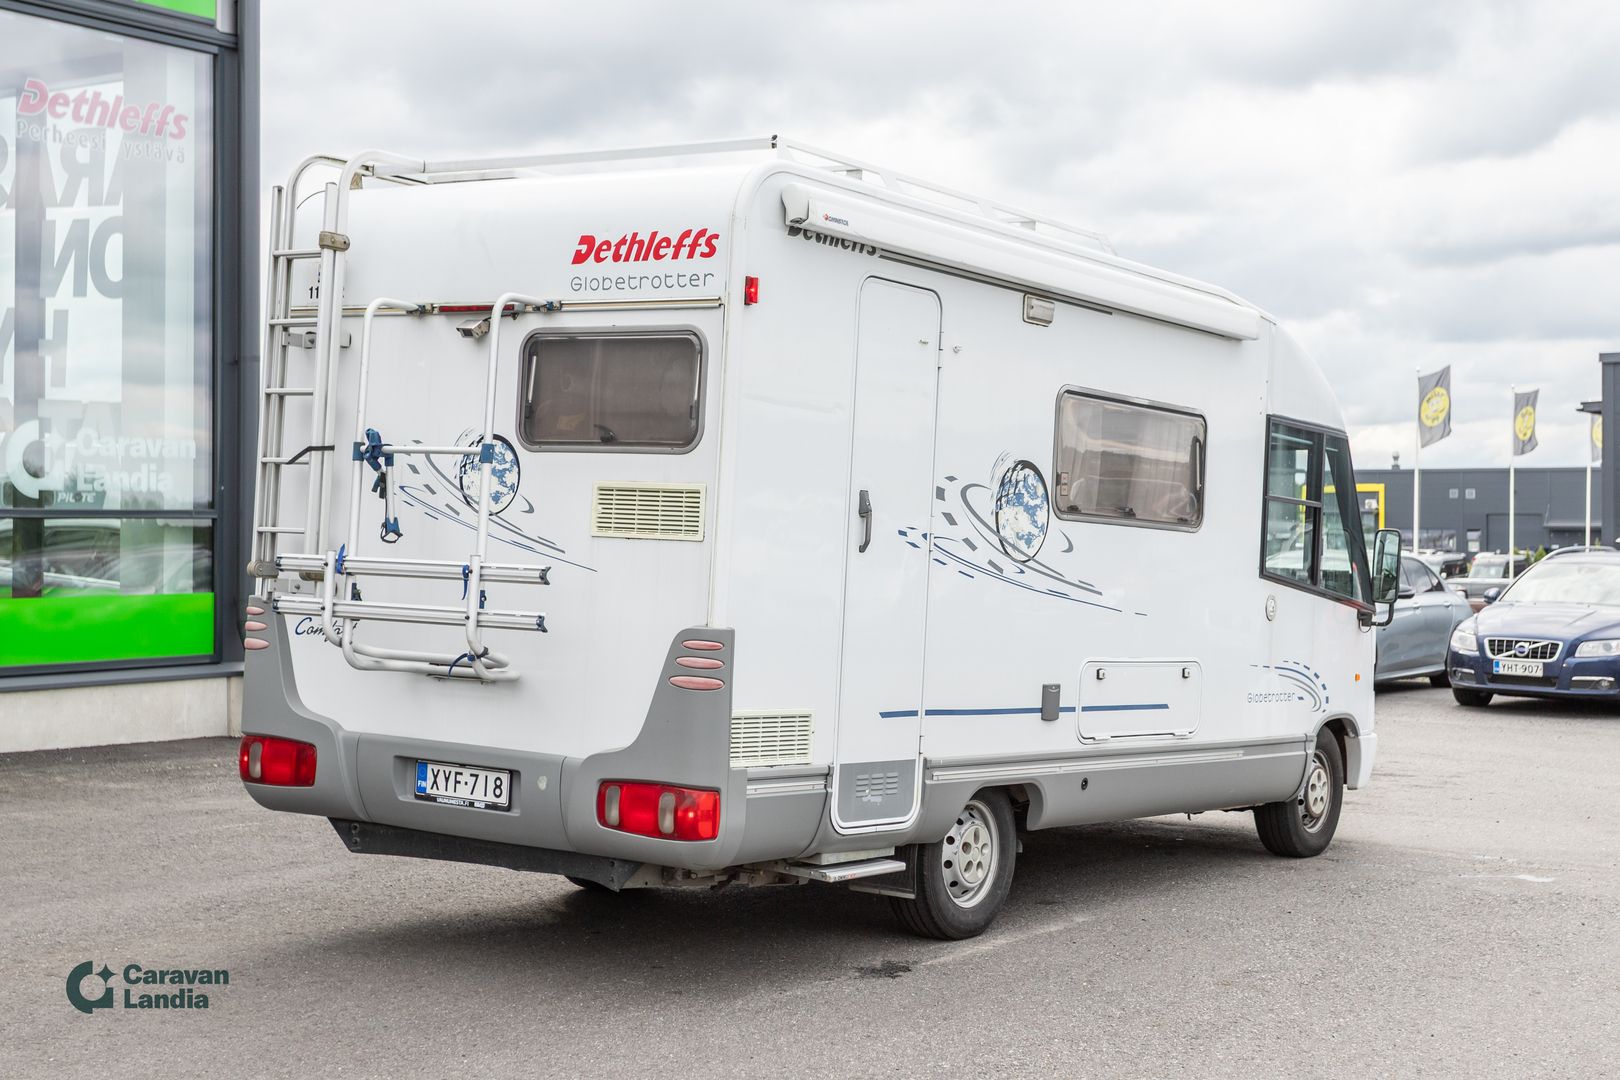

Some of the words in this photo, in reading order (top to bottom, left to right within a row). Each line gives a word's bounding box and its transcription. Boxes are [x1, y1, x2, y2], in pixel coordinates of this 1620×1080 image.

[17, 78, 189, 140] Dethleffs
[17, 119, 106, 151] Perheesi
[123, 141, 186, 164] ystävä
[571, 228, 720, 265] Dethleffs
[570, 271, 715, 292] Globetrotter
[76, 428, 197, 459] Caravan
[76, 463, 178, 492] Landia
[1247, 692, 1296, 704] Globetrotter
[430, 767, 503, 798] XYF-718
